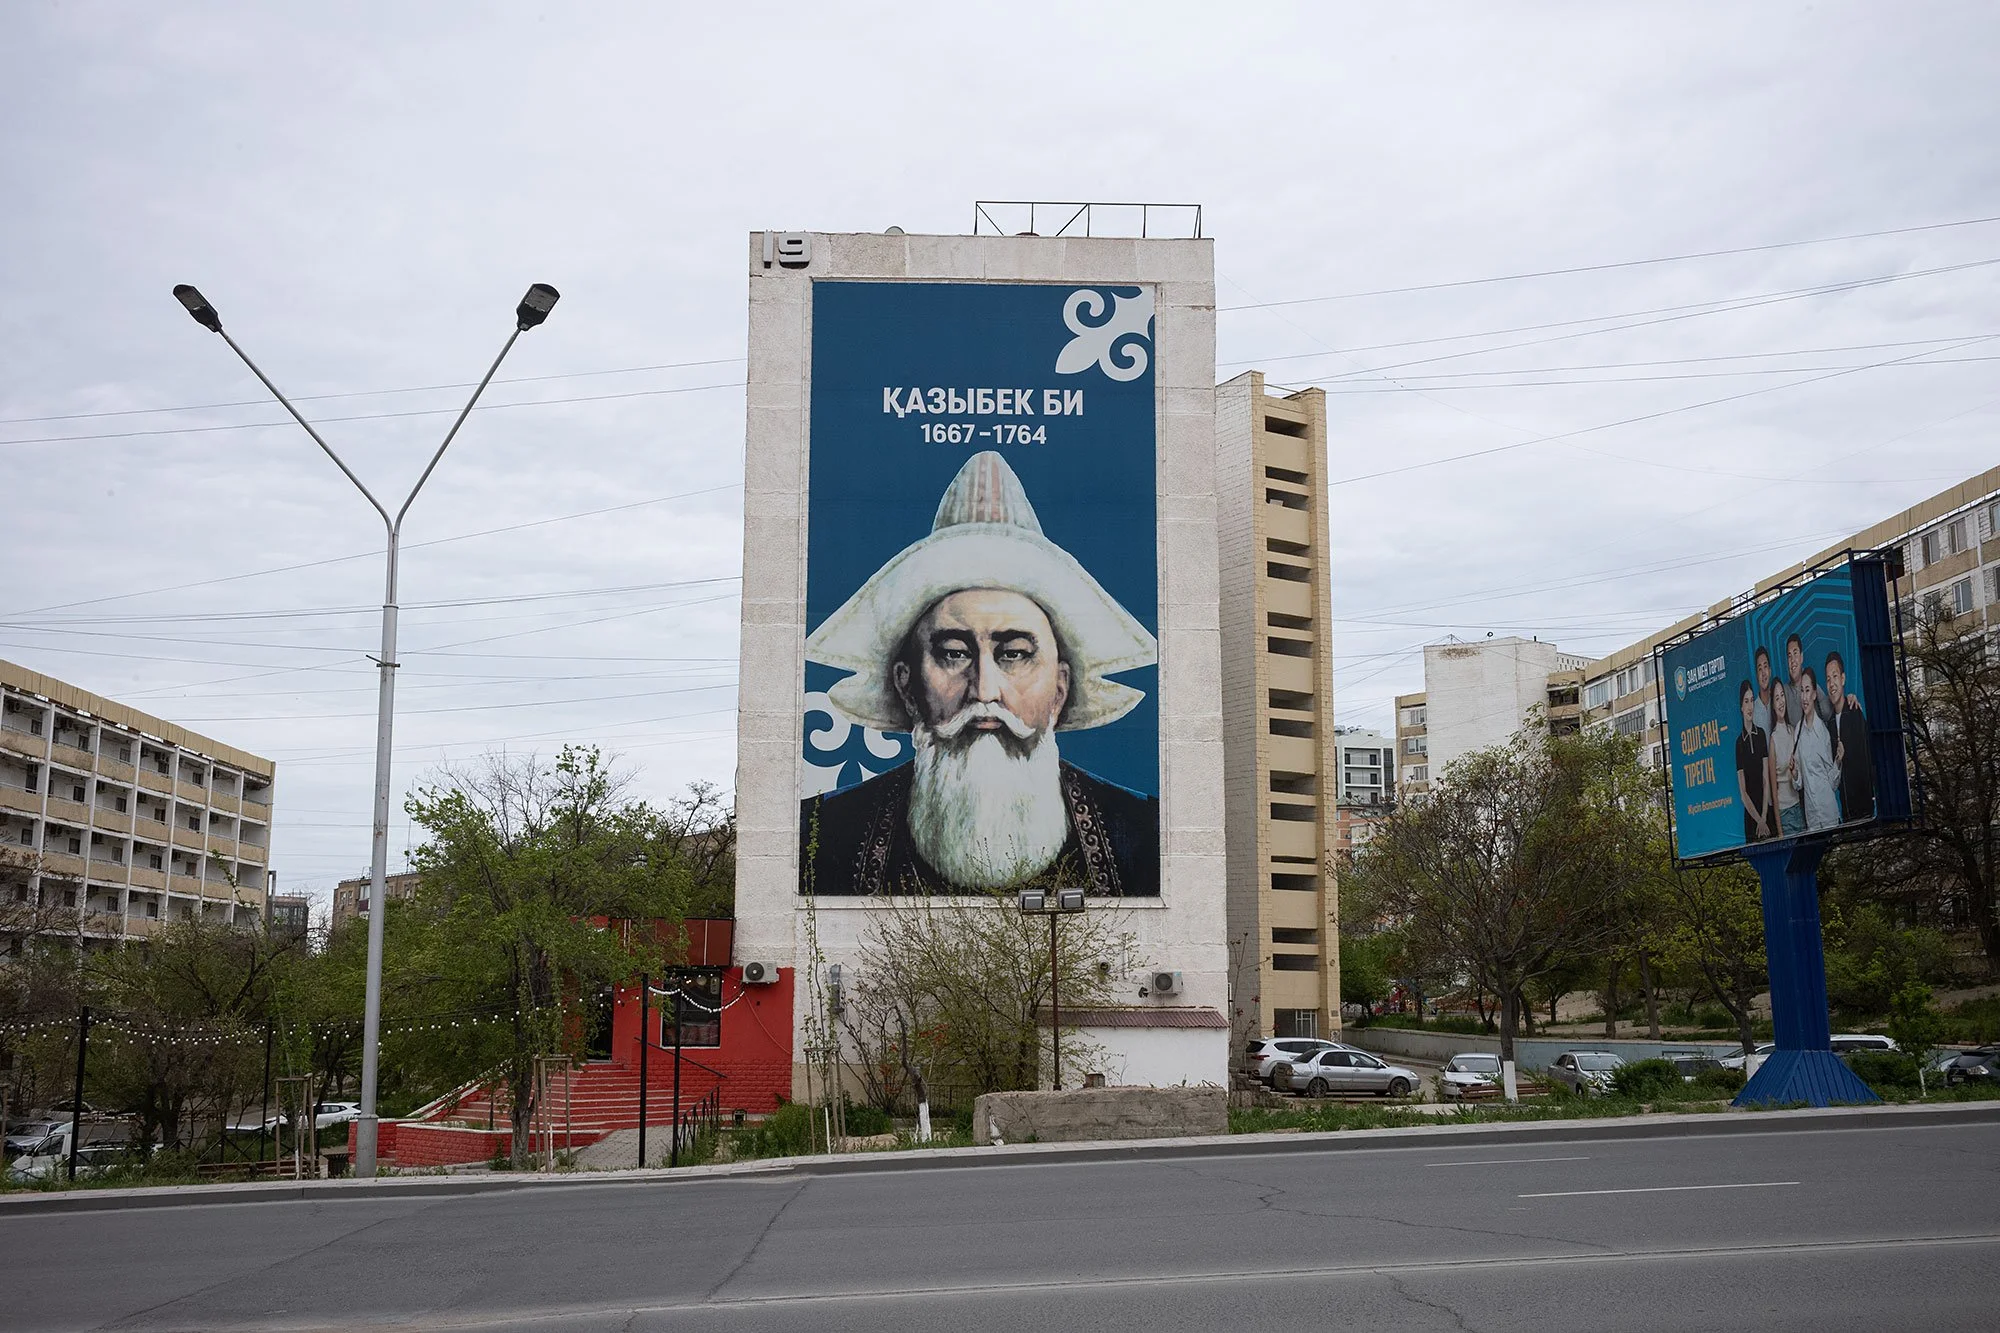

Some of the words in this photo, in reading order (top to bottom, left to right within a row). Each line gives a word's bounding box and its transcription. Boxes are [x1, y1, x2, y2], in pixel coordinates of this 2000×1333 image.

[763, 231, 812, 267] 19
[883, 387, 1035, 418] ҚАЗЫБЕК
[1043, 389, 1084, 416] БИ
[1702, 719, 1720, 747] ЗАҢ
[1684, 757, 1716, 788] ТІРЕГІҢ
